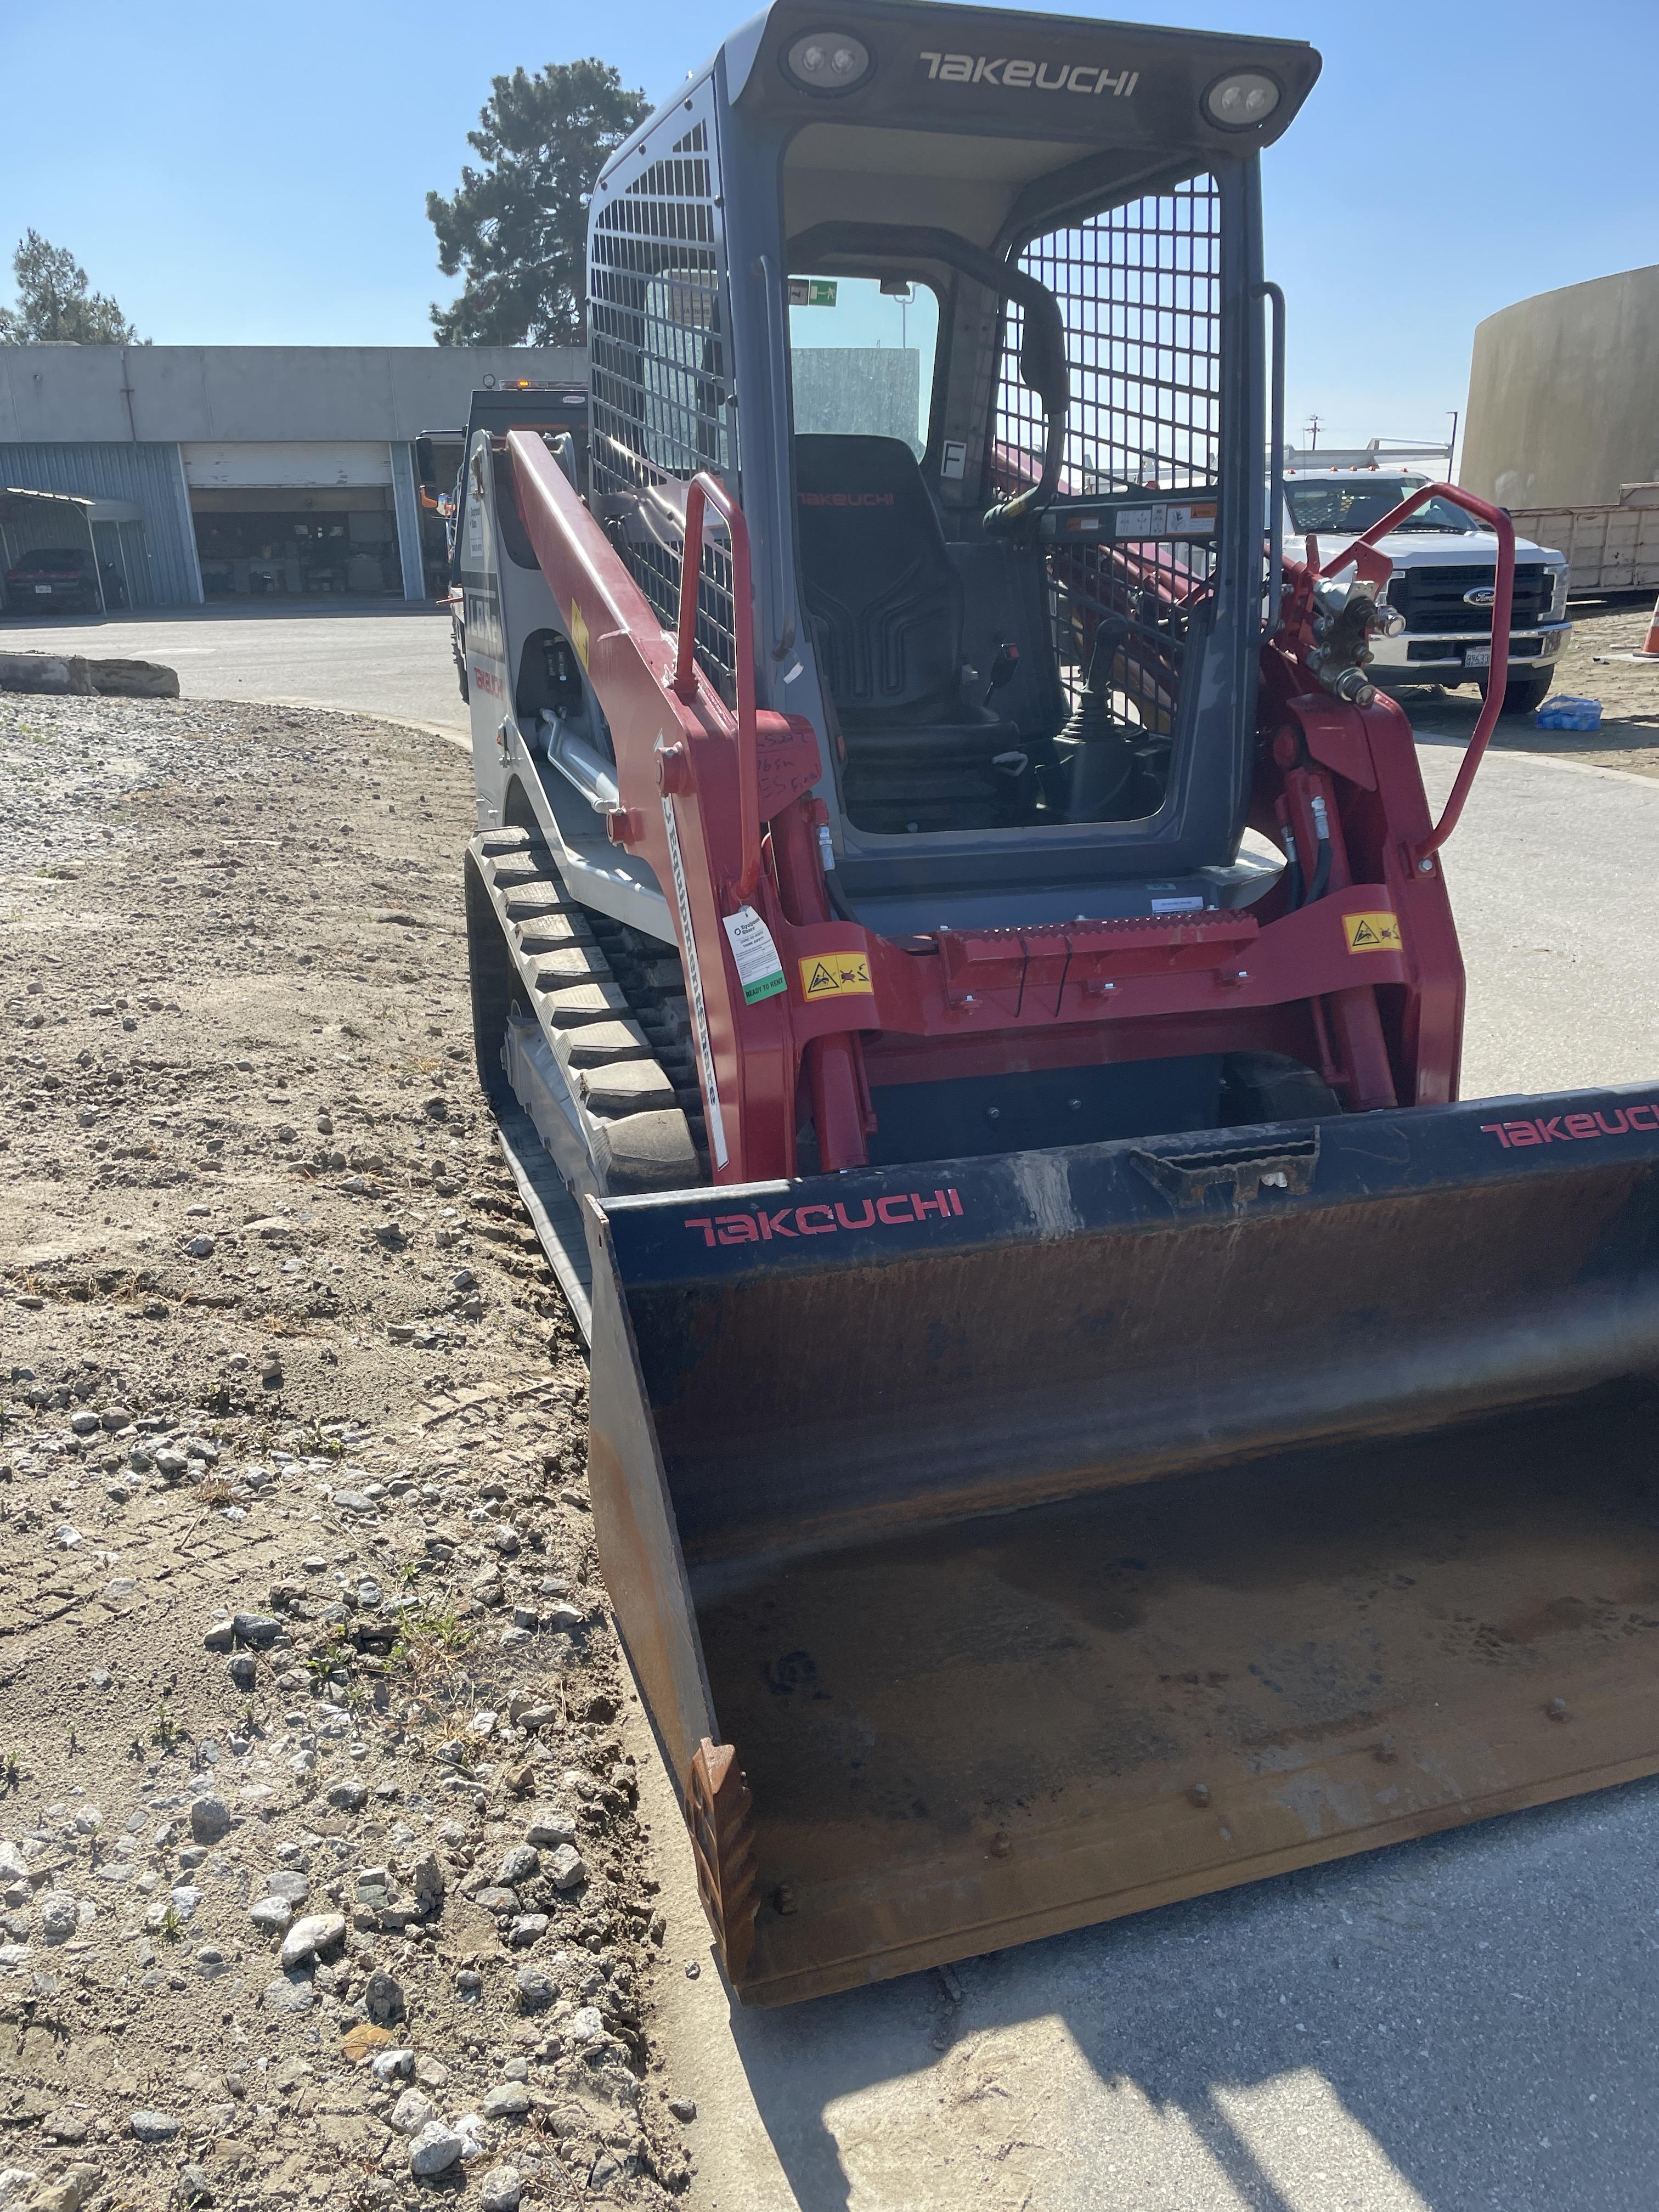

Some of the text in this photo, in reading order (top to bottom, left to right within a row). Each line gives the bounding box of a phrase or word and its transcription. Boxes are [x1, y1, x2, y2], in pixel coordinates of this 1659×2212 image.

[919, 51, 1139, 97] TAKEUCHI
[746, 986, 762, 998] READY
[770, 978, 783, 988] RENT
